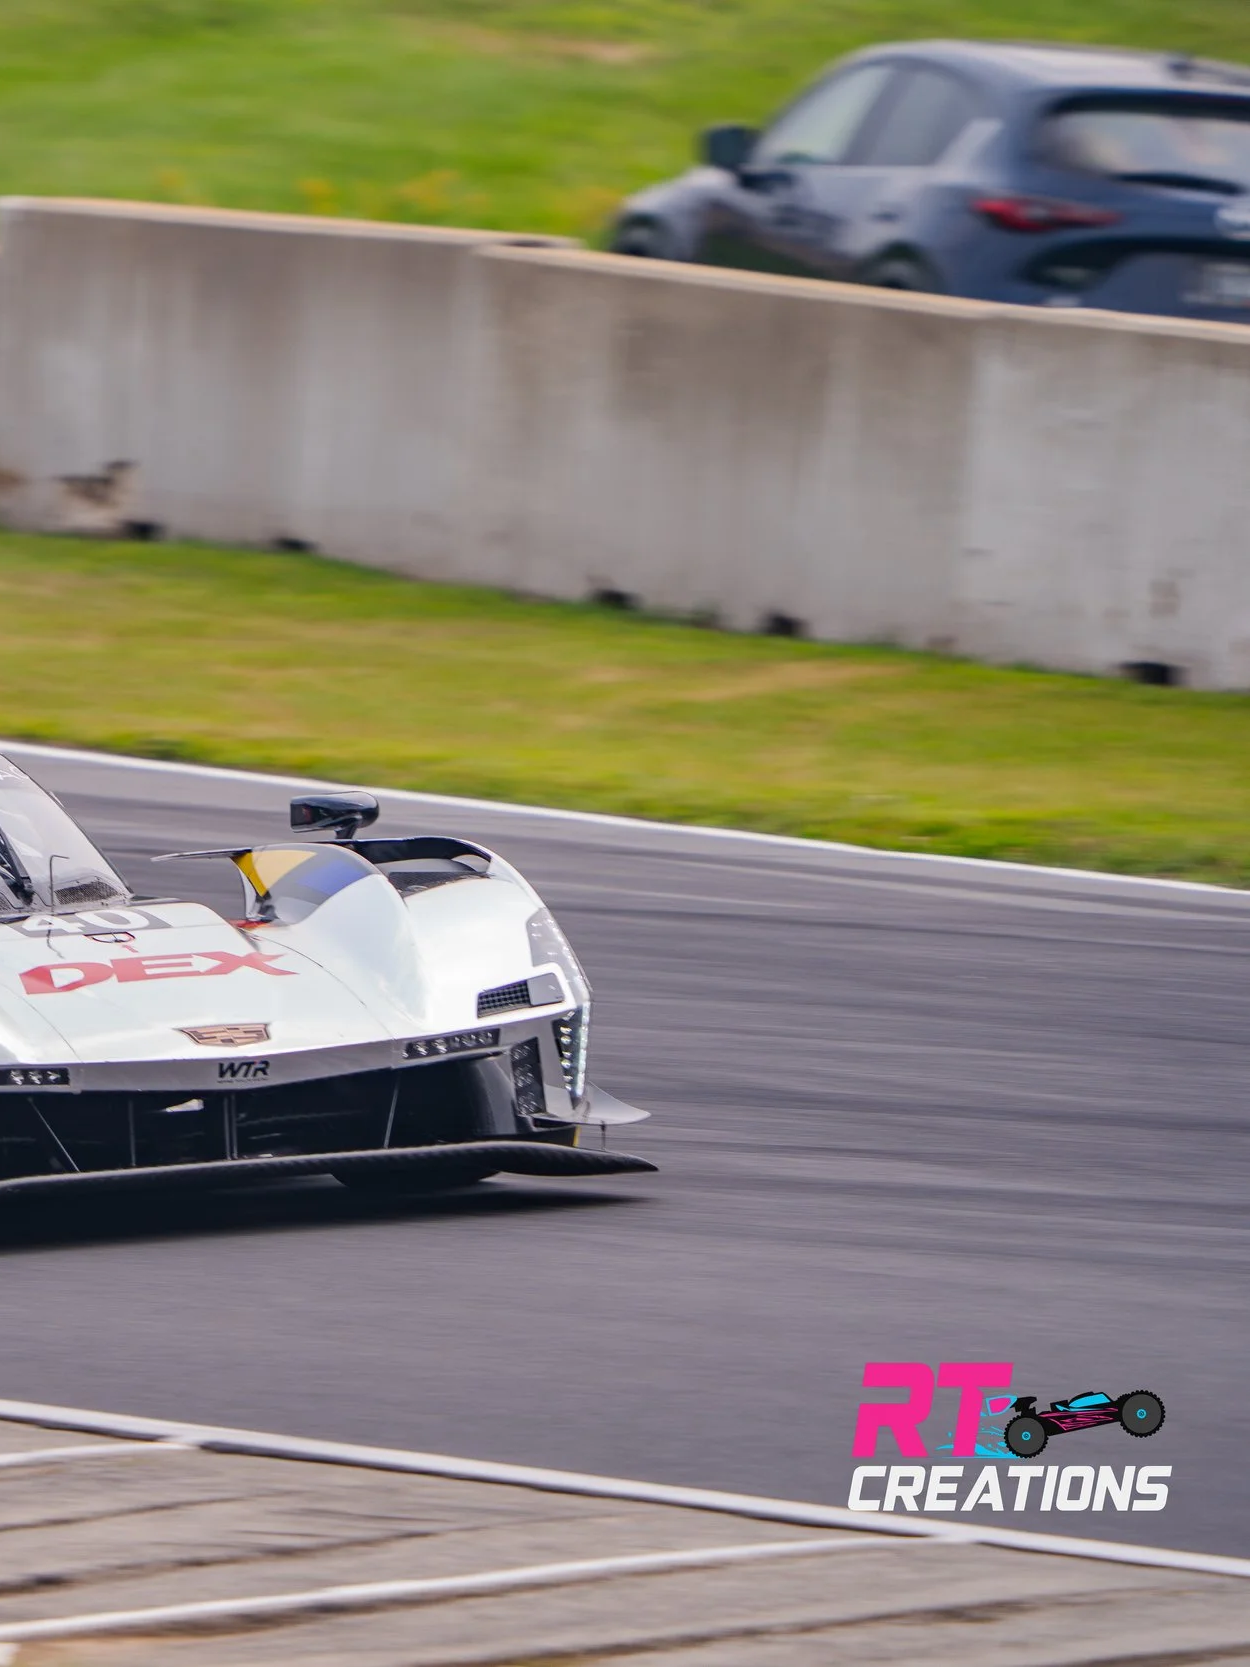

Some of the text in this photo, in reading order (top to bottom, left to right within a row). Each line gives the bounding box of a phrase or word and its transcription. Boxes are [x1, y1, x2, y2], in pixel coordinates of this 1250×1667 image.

[21, 909, 150, 934] 40
[19, 951, 301, 995] DEX
[218, 1060, 270, 1078] WTR
